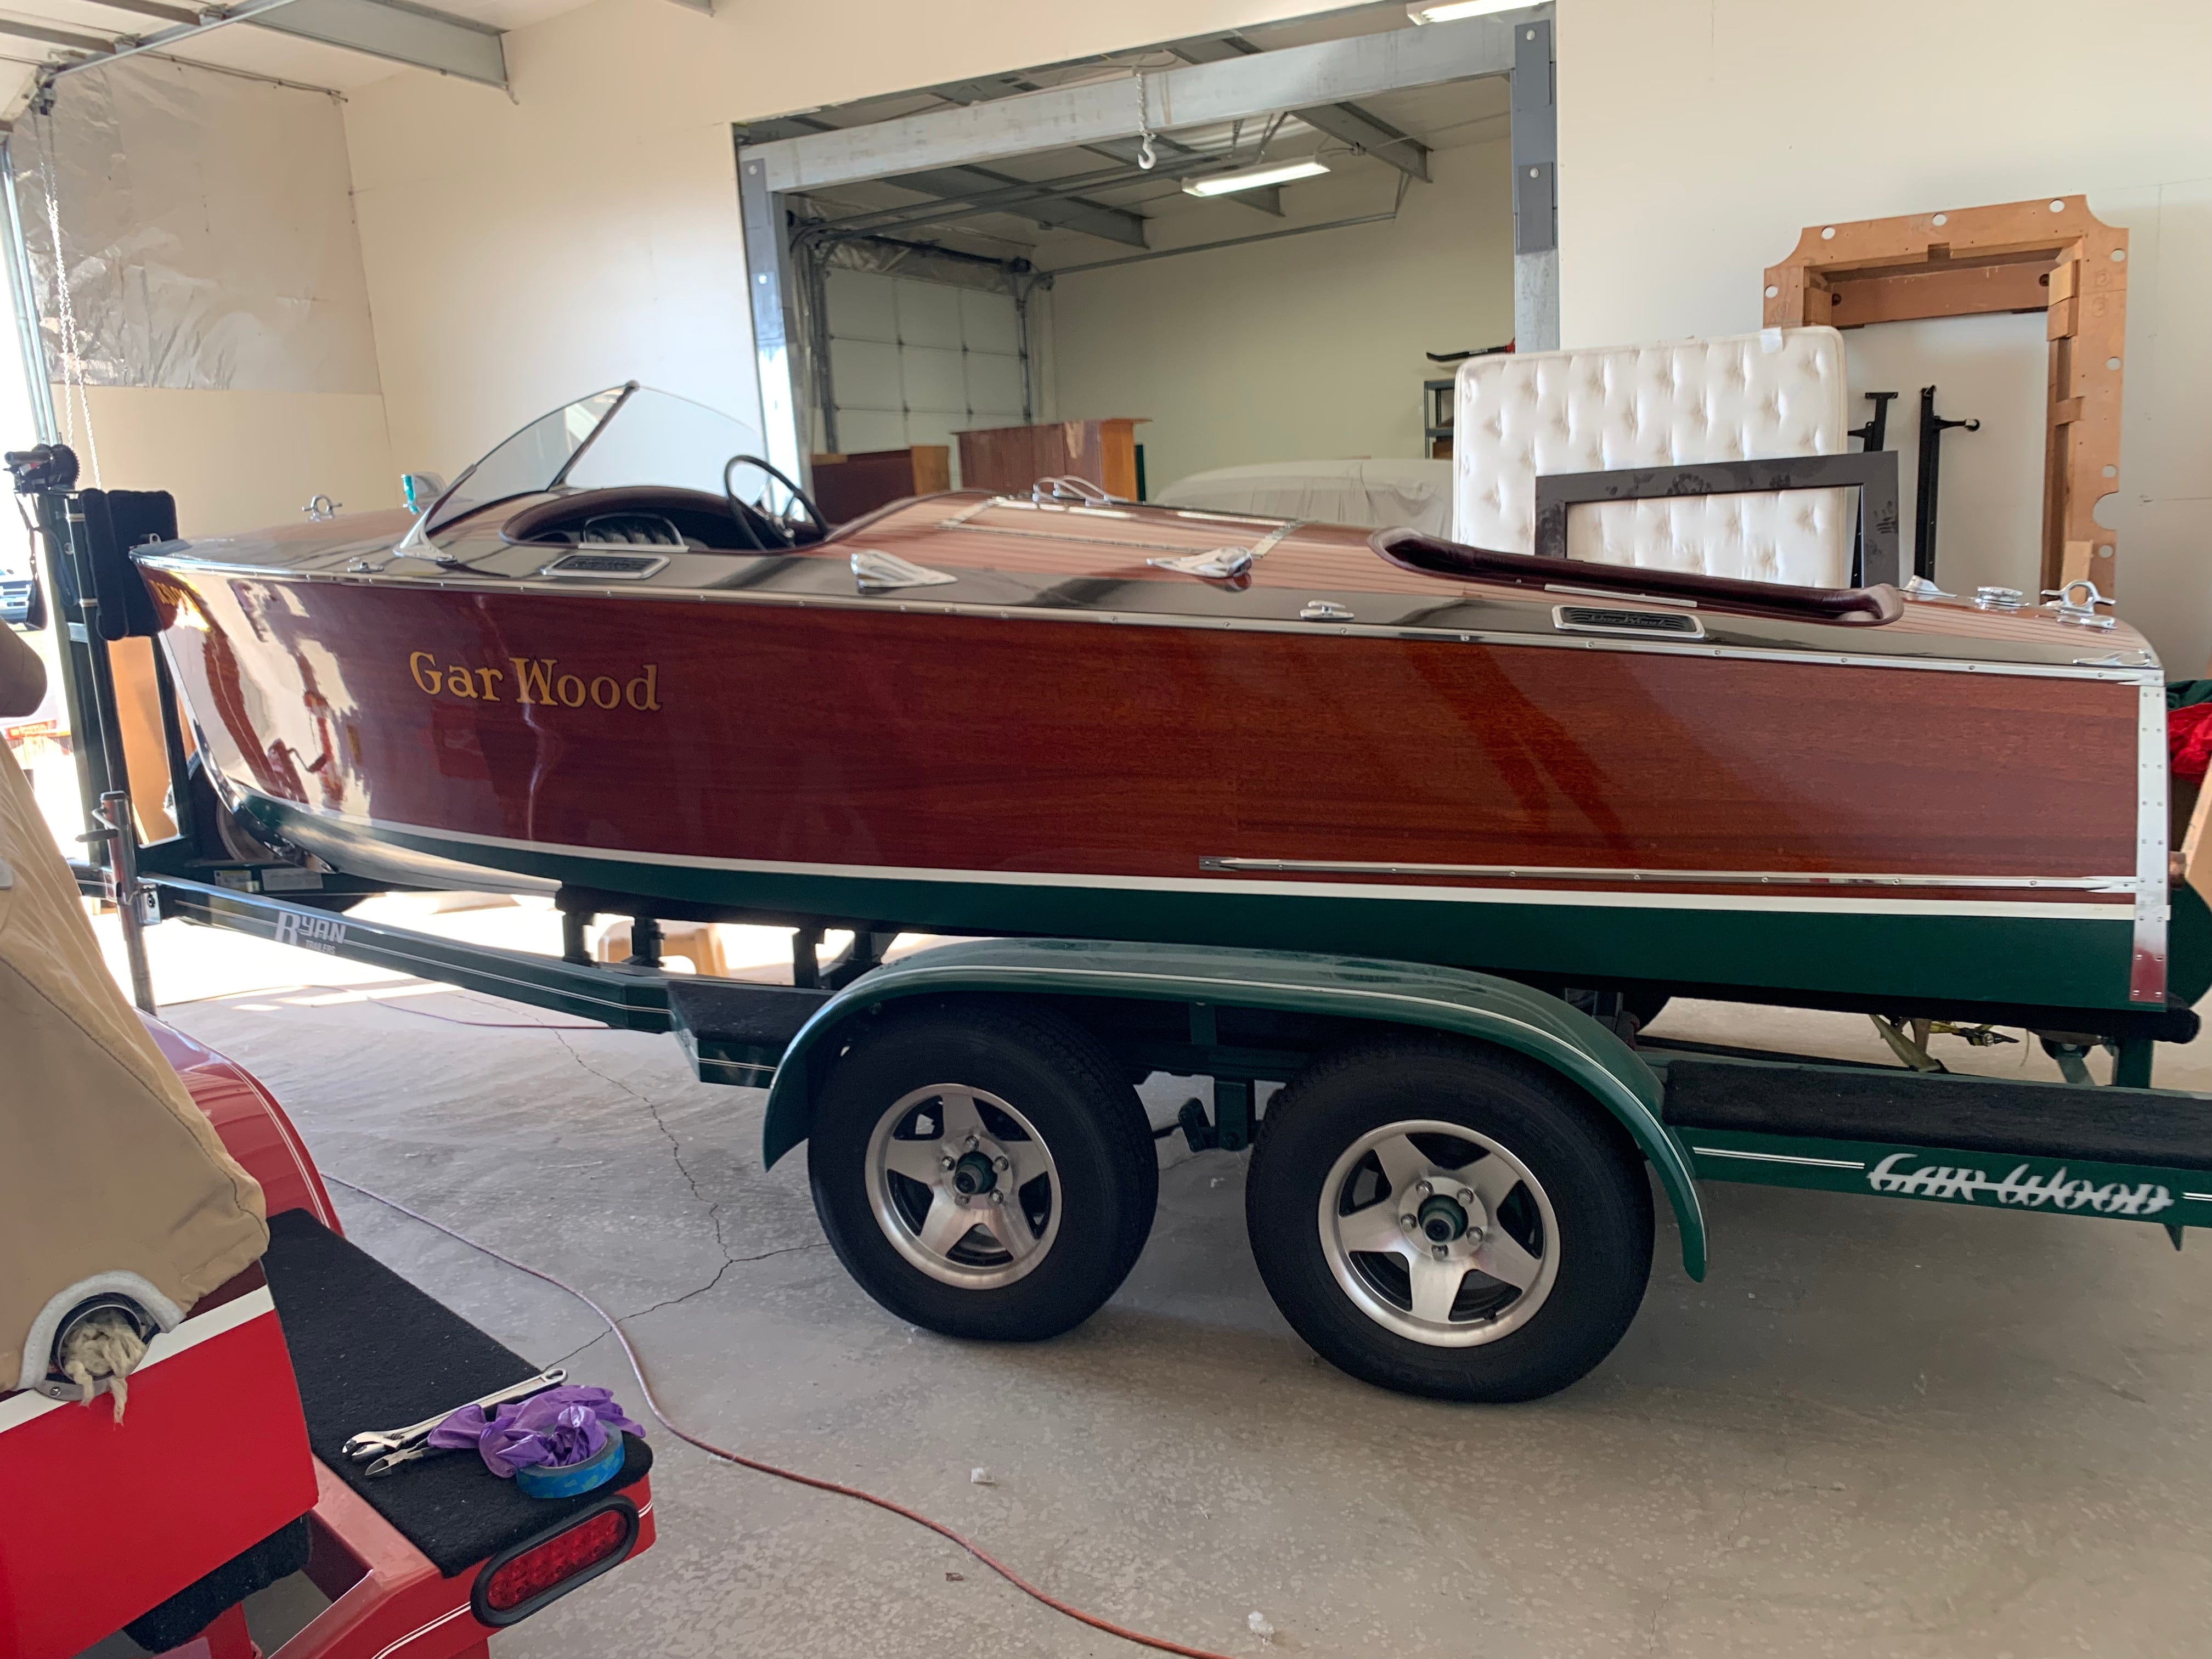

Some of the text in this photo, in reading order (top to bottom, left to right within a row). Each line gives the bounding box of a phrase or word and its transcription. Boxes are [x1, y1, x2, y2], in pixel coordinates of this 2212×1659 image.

[409, 650, 662, 712] Gar Wood
[275, 911, 347, 946] RYAN
[306, 939, 336, 955] TRAILERS
